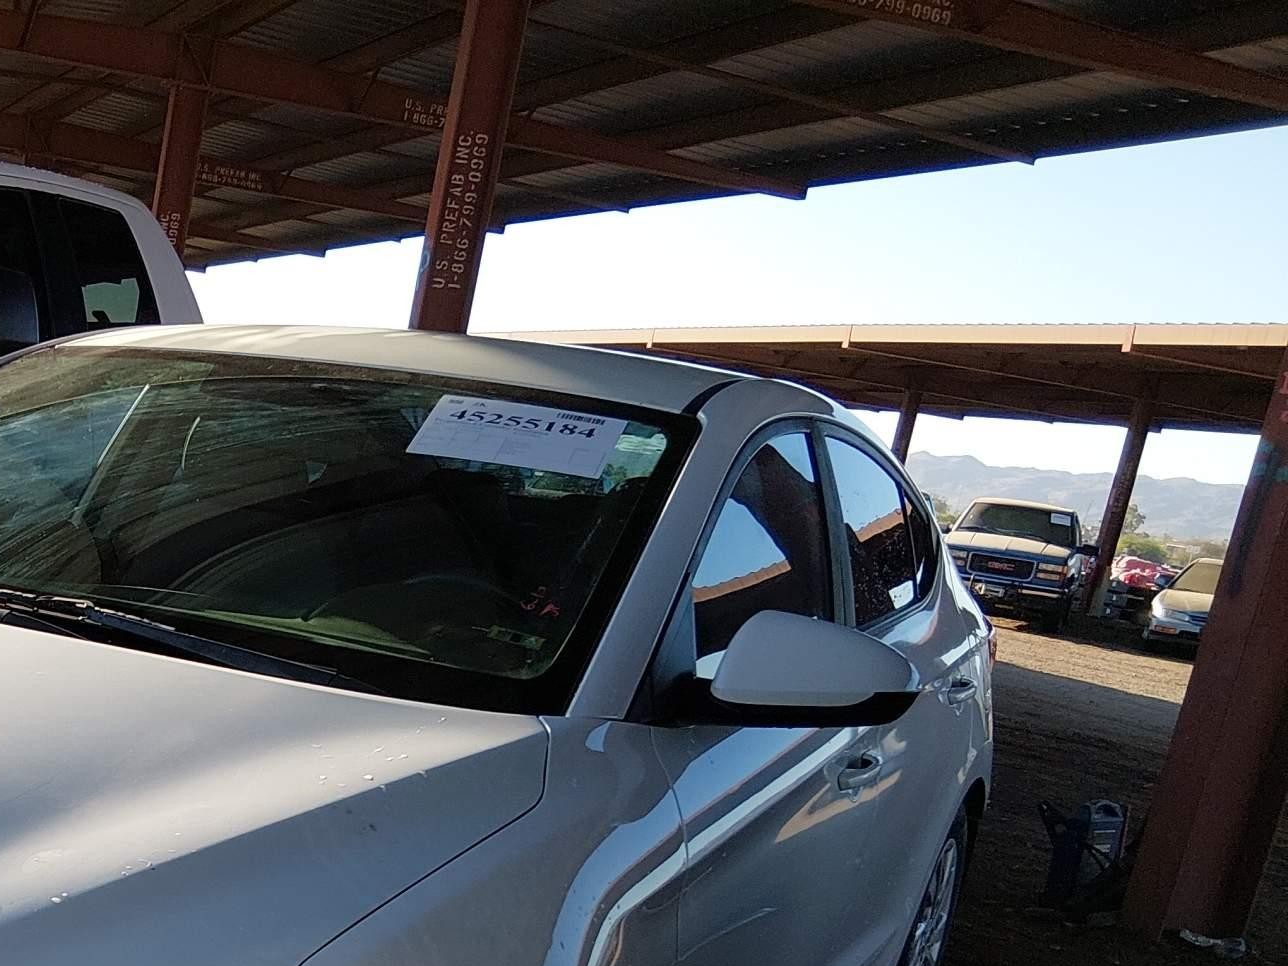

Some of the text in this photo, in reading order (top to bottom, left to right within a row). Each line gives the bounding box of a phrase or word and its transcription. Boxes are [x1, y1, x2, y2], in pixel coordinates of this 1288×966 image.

[405, 97, 424, 113] U.S.
[432, 130, 475, 288] U.S. PREFAB INC.
[447, 133, 490, 289] 1-866-799-0969
[449, 409, 596, 439] 45255184
